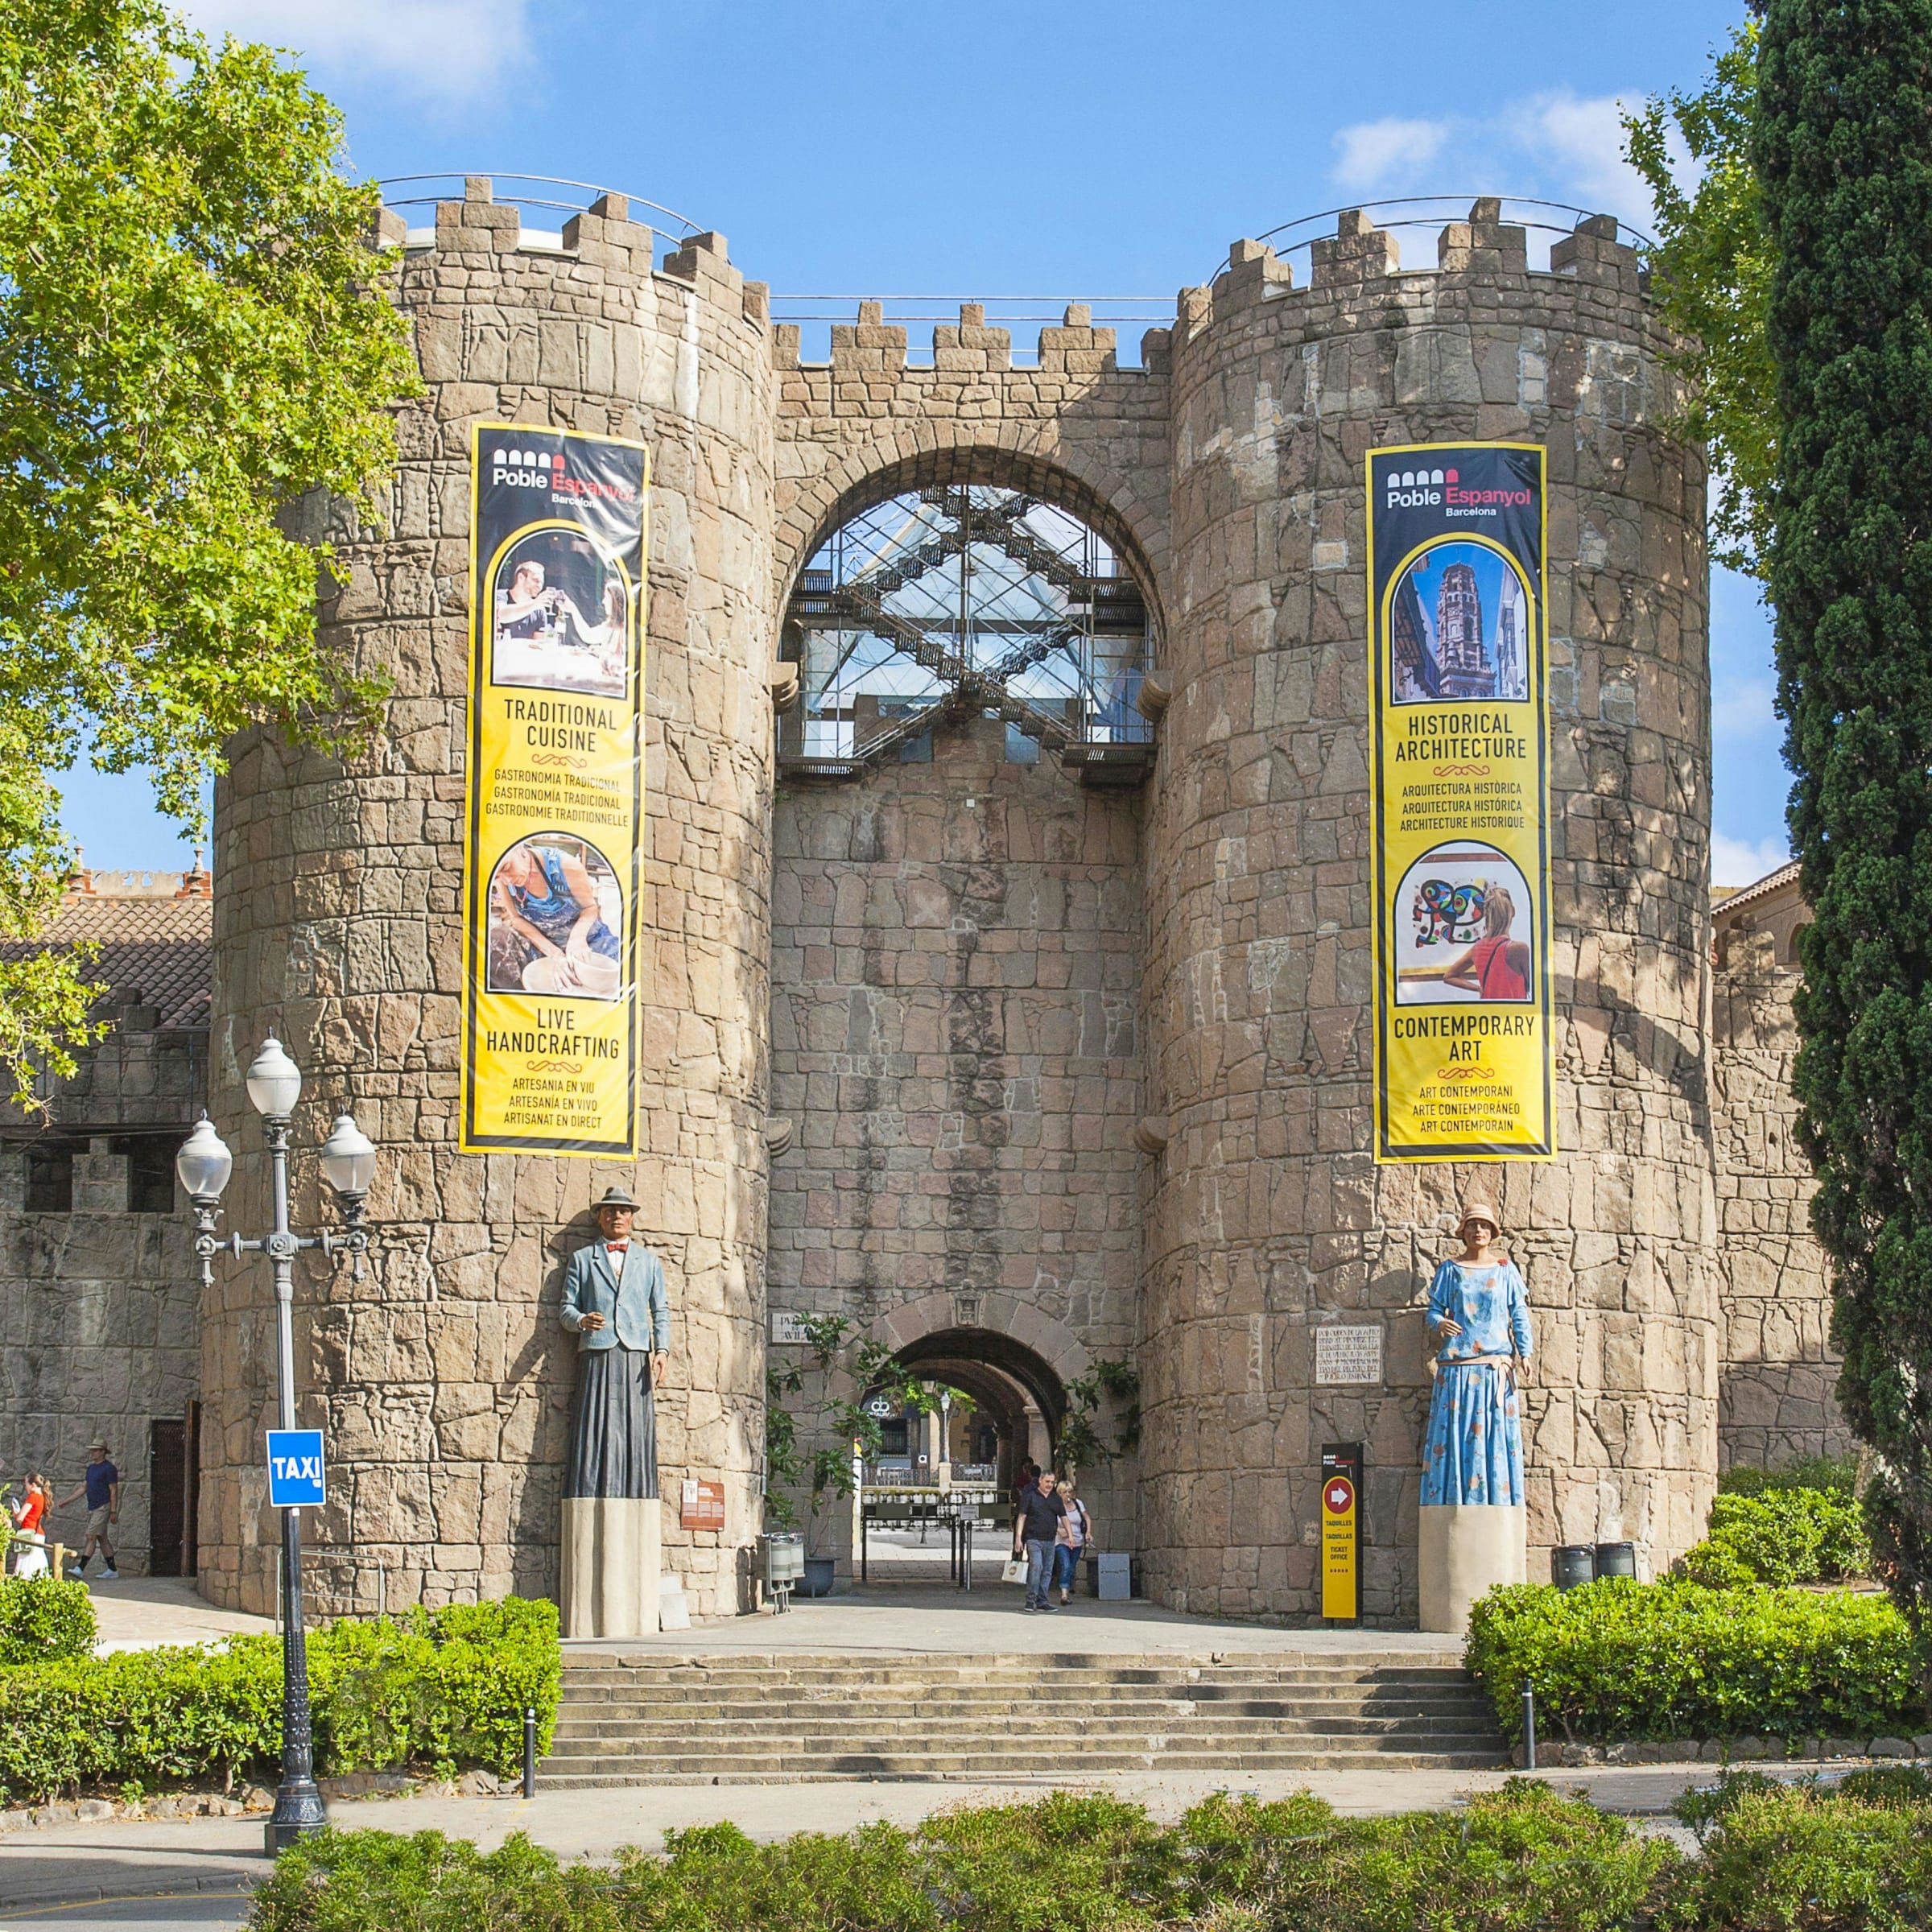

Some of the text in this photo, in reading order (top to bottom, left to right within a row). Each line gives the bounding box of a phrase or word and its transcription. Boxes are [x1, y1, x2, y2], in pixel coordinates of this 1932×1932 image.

[493, 468, 547, 489] Poble
[1387, 486, 1531, 509] Poble Espanyol
[1446, 507, 1496, 517] Barcelona
[504, 699, 617, 730] TRADITIONAL
[1409, 713, 1513, 737] HISTORICAL
[527, 725, 596, 752] CUISINE
[1395, 738, 1526, 762] ARCHITECTURE
[494, 768, 621, 792] GASTRONOMIA TRADICIONAL
[1402, 779, 1521, 798] ARQUITECTURA HISTÒRICA
[493, 786, 621, 810] GASTRONOMÍA TRADICIONAL
[1402, 798, 1522, 815] ARQUITECTURA HISTÓRICA
[485, 803, 629, 827] GASTRONOMIE TRADITIONNELLE
[1400, 815, 1525, 832] ARCHITECTURE HISTORIQUE
[537, 1008, 575, 1030] LIVE
[1394, 1015, 1534, 1038] CONTEMPORARY
[486, 1031, 619, 1059] HANDCRAFTING
[1449, 1041, 1482, 1061] ART
[513, 1078, 594, 1093] ARTESANIA EN VIU
[1419, 1085, 1513, 1099] ART CONTEMPORANI
[509, 1095, 597, 1112] ARTESANÍA EN VIVO
[1413, 1101, 1520, 1116] ARTE CONTEMPORÁNEO
[504, 1113, 601, 1129] ARTISANAT EN DIRECT
[1420, 1120, 1513, 1133] ART CONTEMPORAIN
[272, 1456, 320, 1480] TAXI
